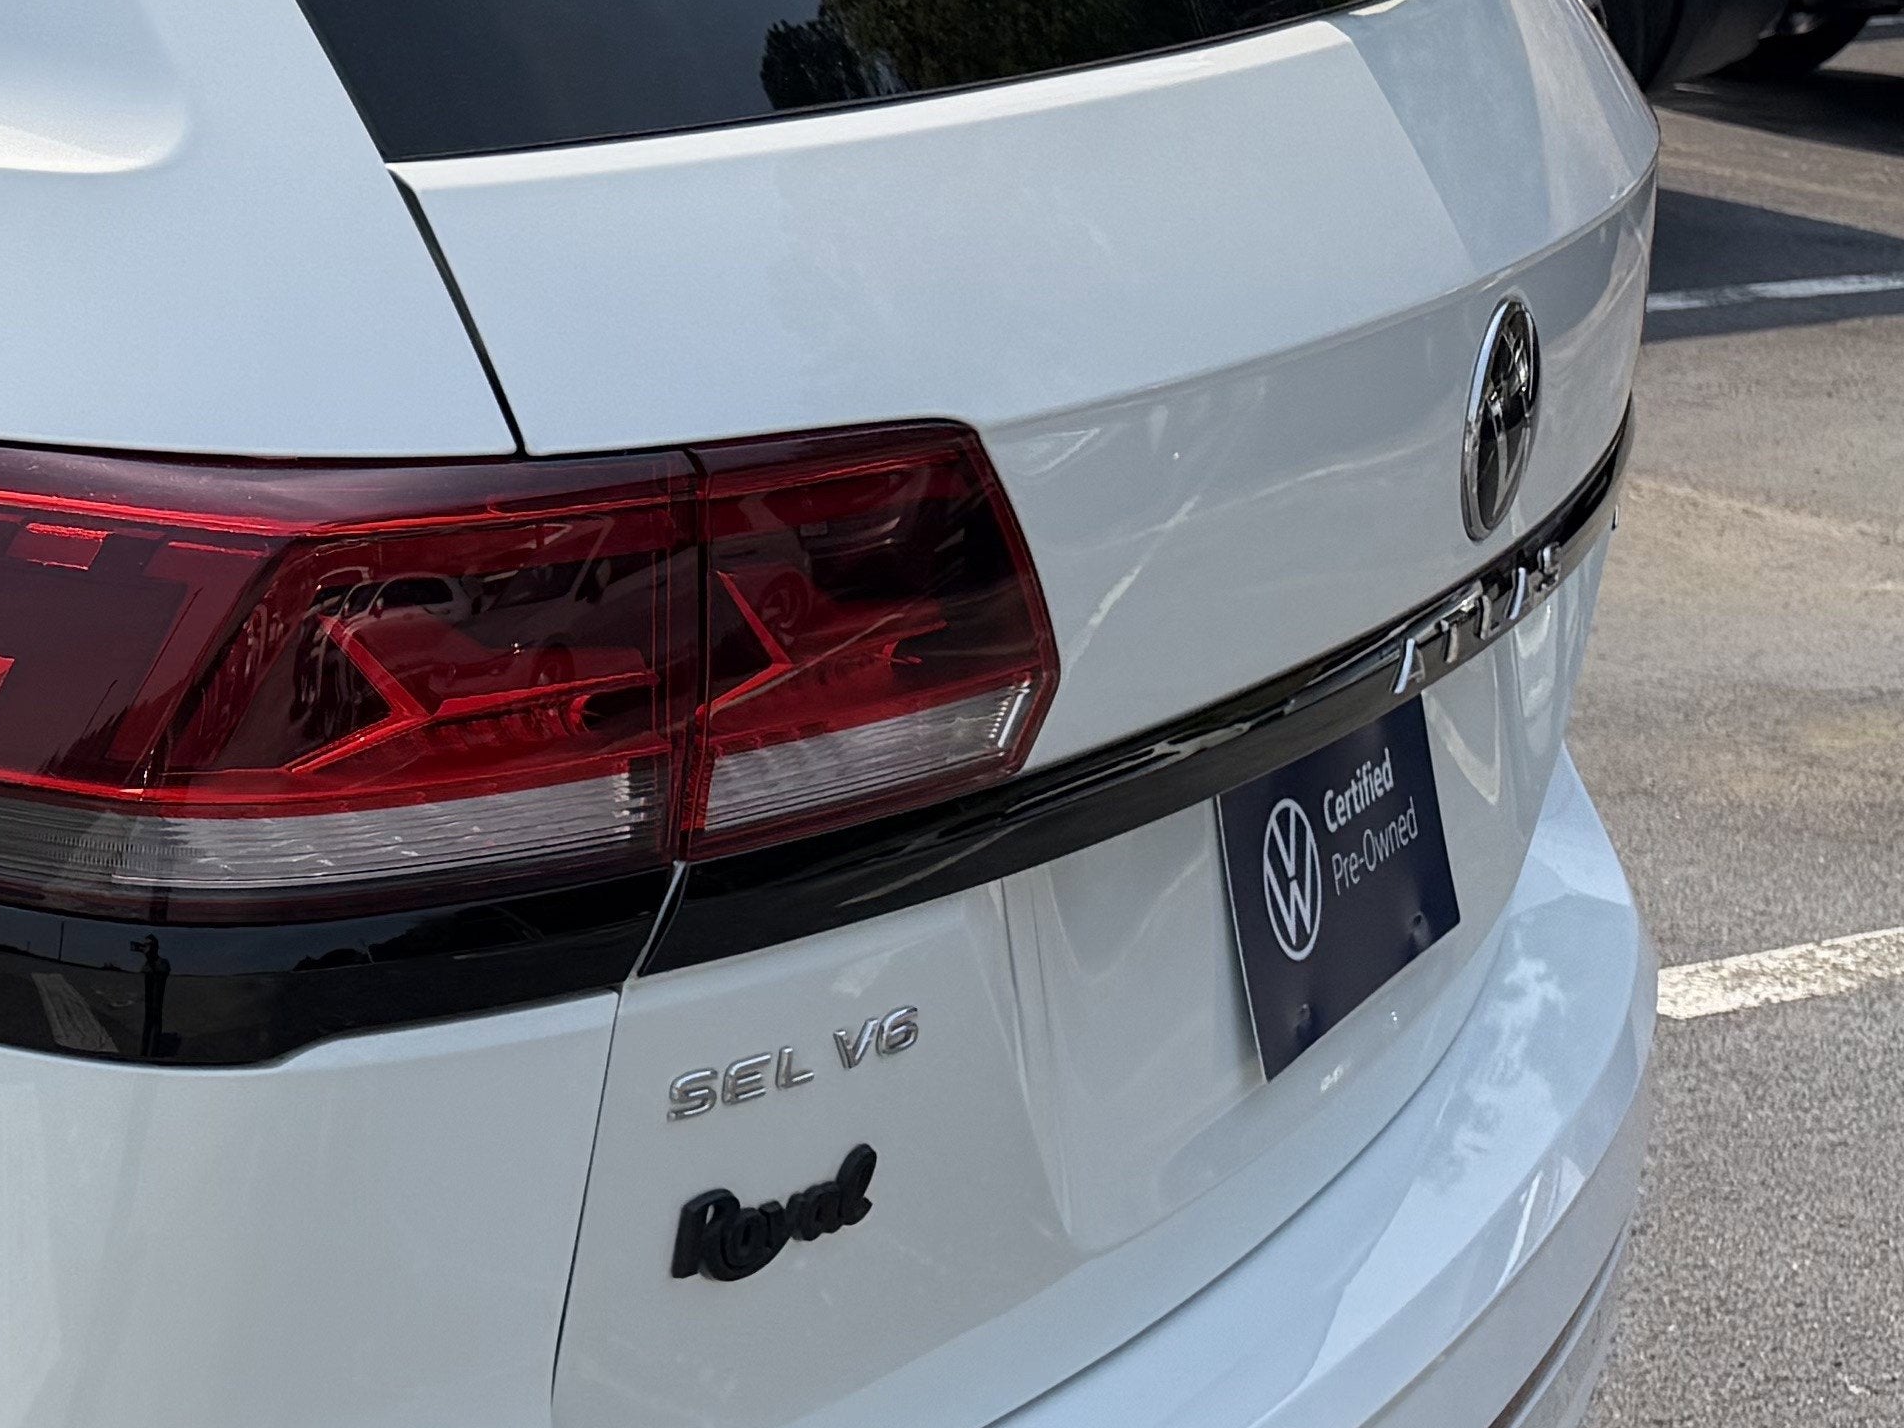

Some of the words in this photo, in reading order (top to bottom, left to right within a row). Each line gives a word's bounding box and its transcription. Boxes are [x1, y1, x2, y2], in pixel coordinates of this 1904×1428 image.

[1390, 540, 1563, 696] ATLAS
[1323, 746, 1395, 834] Certified
[1331, 795, 1420, 897] Pre-Owned
[666, 1044, 816, 1123] SEL
[832, 1004, 920, 1070] V6
